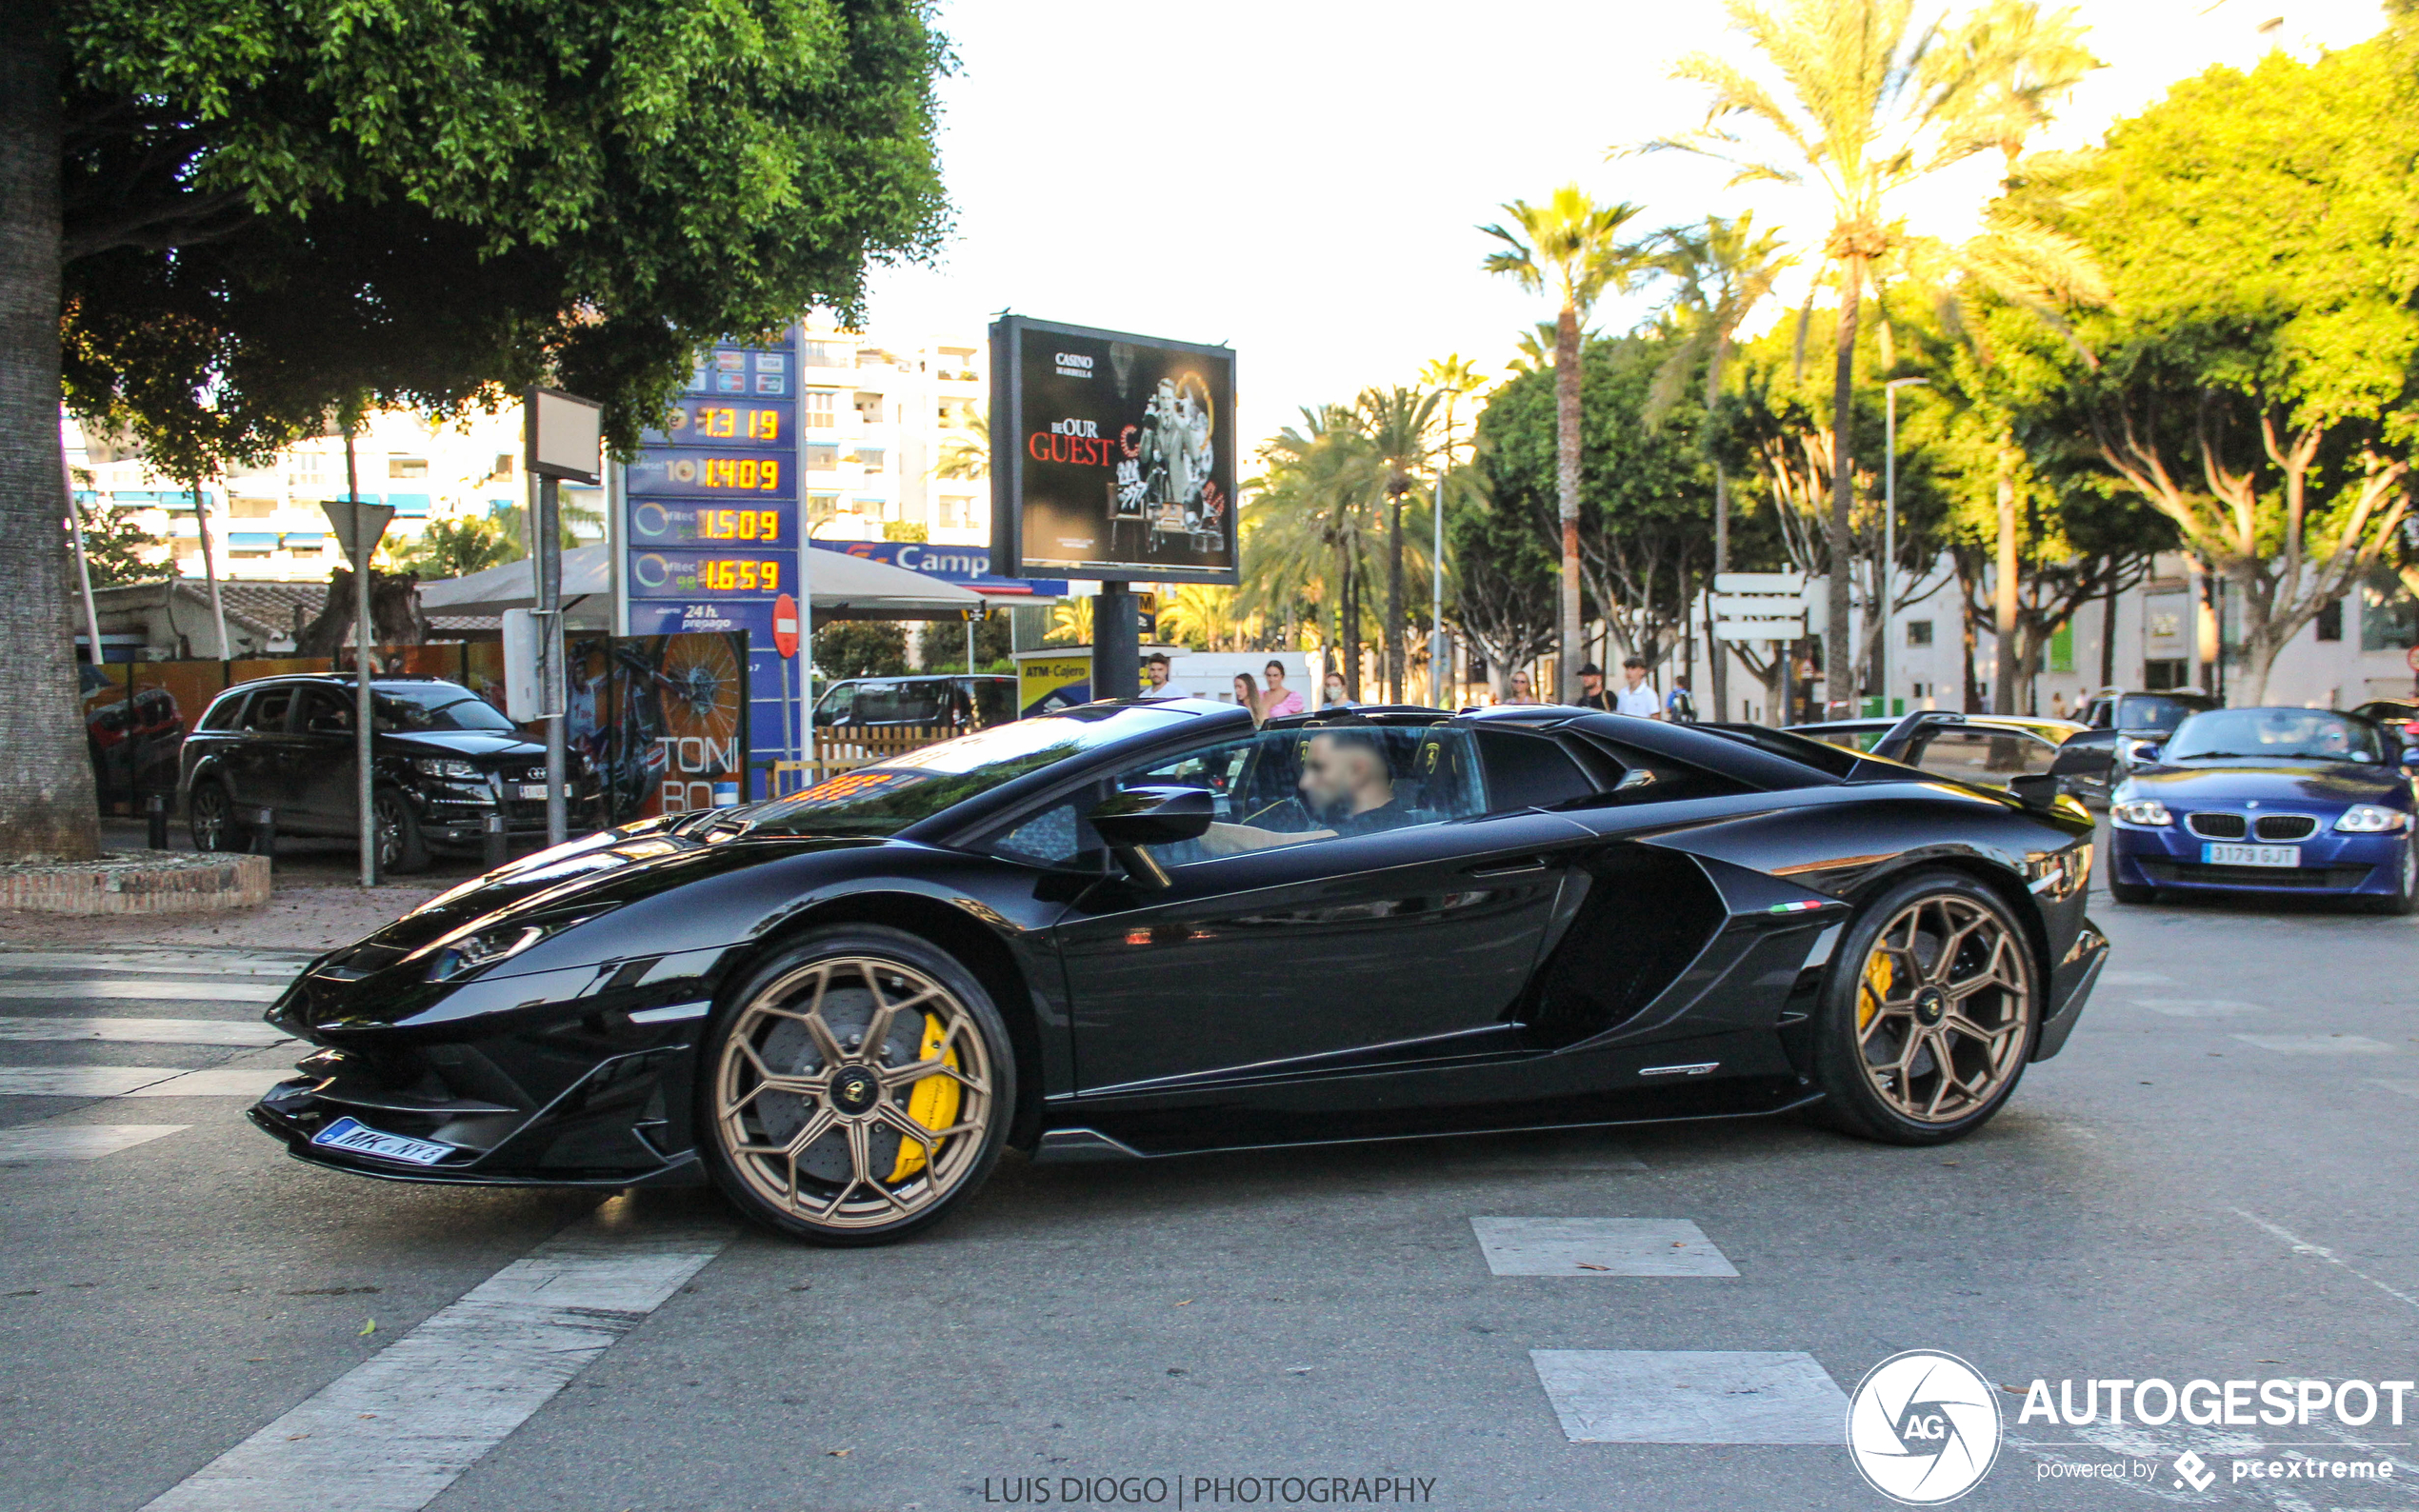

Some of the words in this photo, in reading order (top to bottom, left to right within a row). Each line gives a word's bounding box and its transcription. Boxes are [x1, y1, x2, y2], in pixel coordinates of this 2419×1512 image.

[1055, 352, 1094, 369] CASINO
[705, 408, 779, 440] 1.319
[1063, 418, 1099, 439] OUR
[1029, 431, 1115, 468] GUEST
[705, 458, 779, 490] 1.409
[705, 509, 780, 540] 1.509
[675, 575, 697, 590] 98
[705, 560, 780, 590] 1.659
[684, 605, 704, 619] 24
[681, 619, 732, 629] prepago
[654, 736, 739, 773] TONI
[2213, 846, 2254, 863] 3179
[2261, 848, 2295, 864] GJT
[338, 1131, 392, 1149] MK
